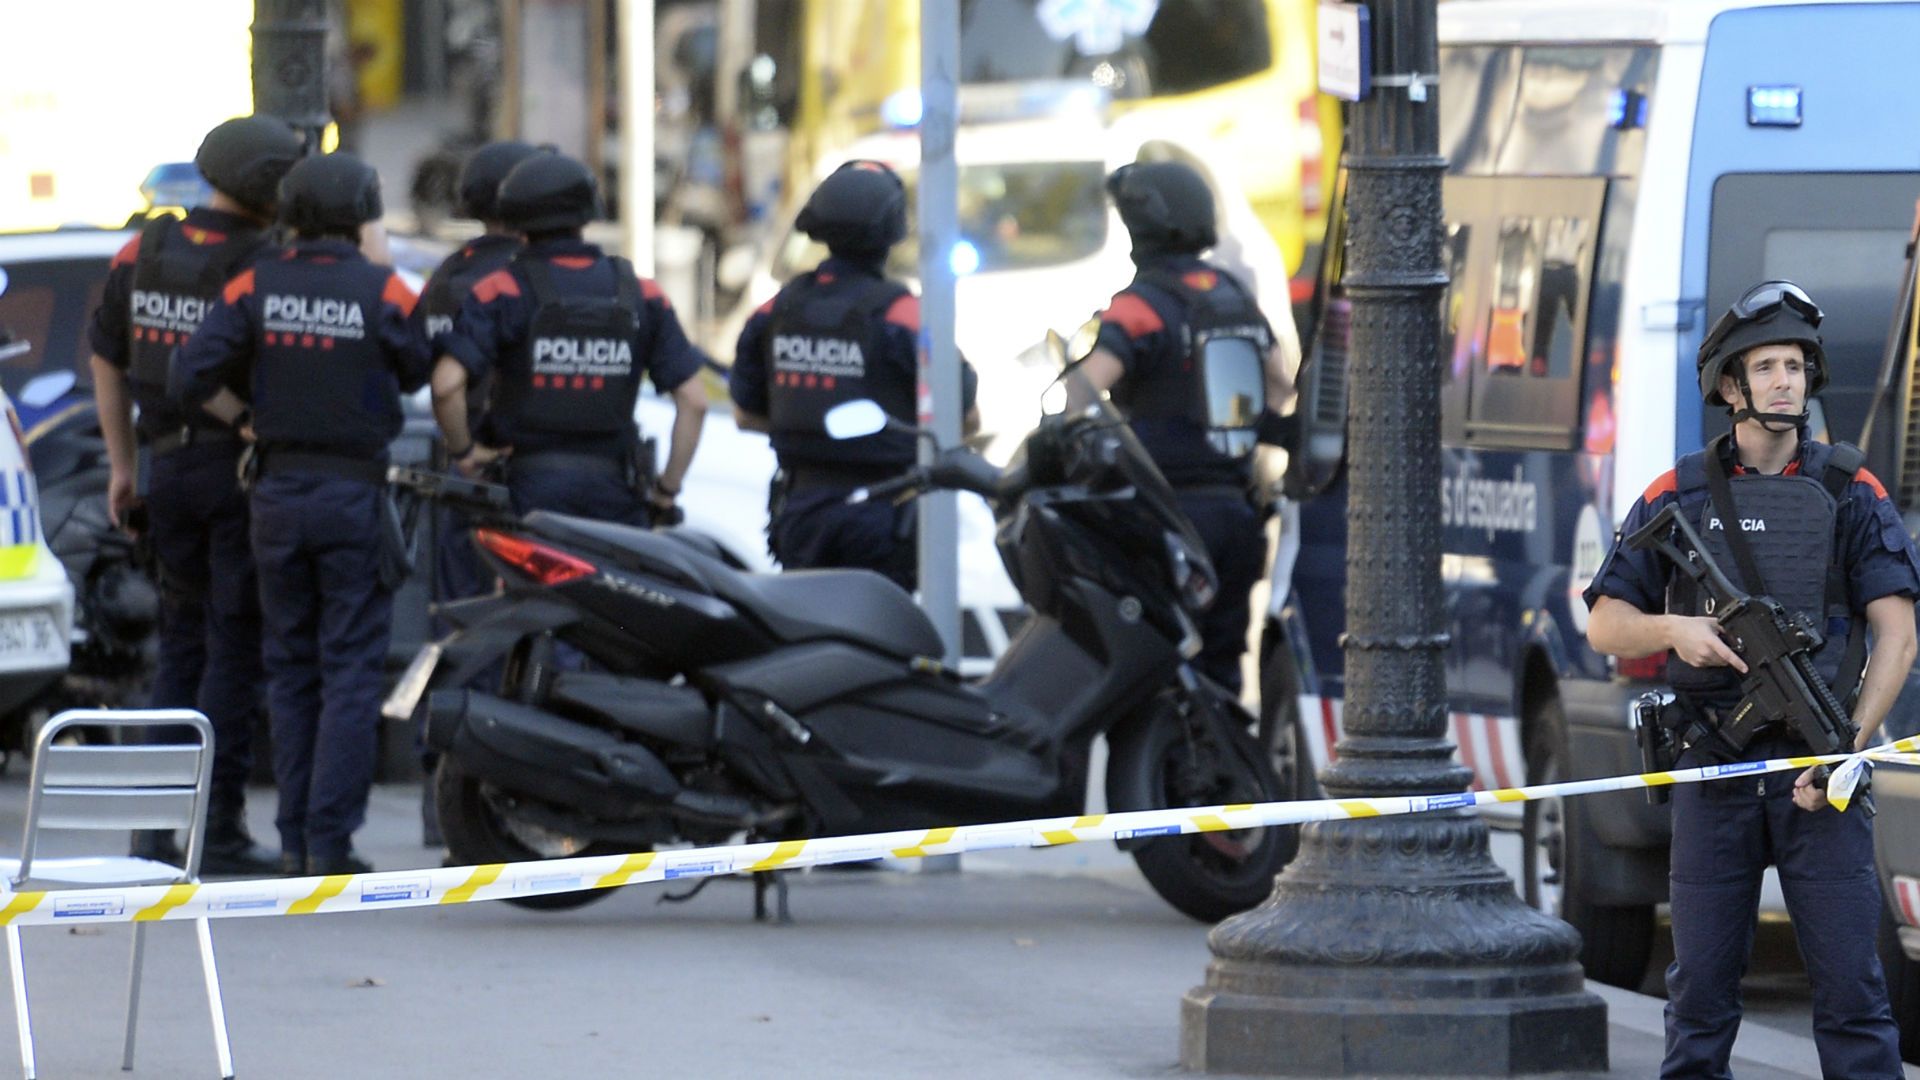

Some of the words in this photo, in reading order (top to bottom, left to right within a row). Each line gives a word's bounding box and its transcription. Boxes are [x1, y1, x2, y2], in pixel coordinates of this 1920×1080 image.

[264, 294, 364, 328] POLICIA
[534, 338, 632, 364] POLICIA
[773, 336, 864, 367] POLICIA
